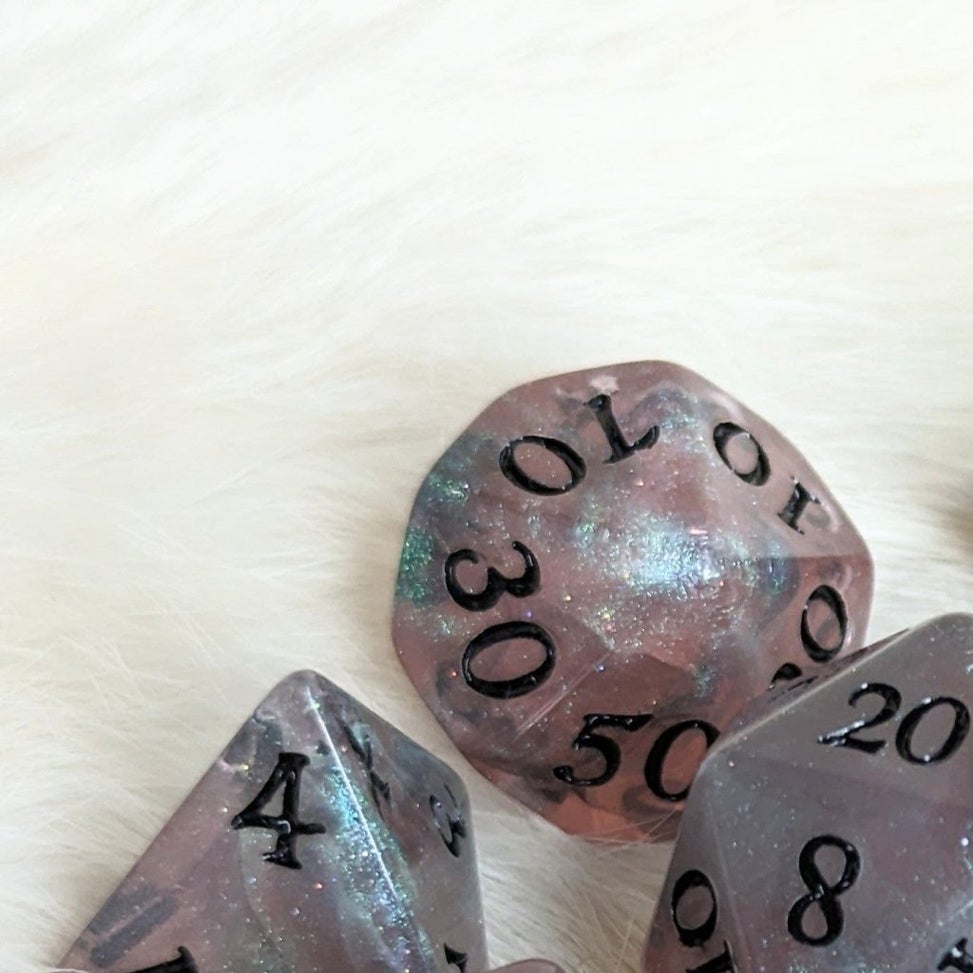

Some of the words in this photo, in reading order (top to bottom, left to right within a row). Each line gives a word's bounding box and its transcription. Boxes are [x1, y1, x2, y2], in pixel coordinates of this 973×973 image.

[444, 540, 556, 699] 30
[553, 714, 719, 801] 50
[818, 683, 970, 765] 20
[231, 752, 326, 869] 4
[787, 835, 860, 947] 8
